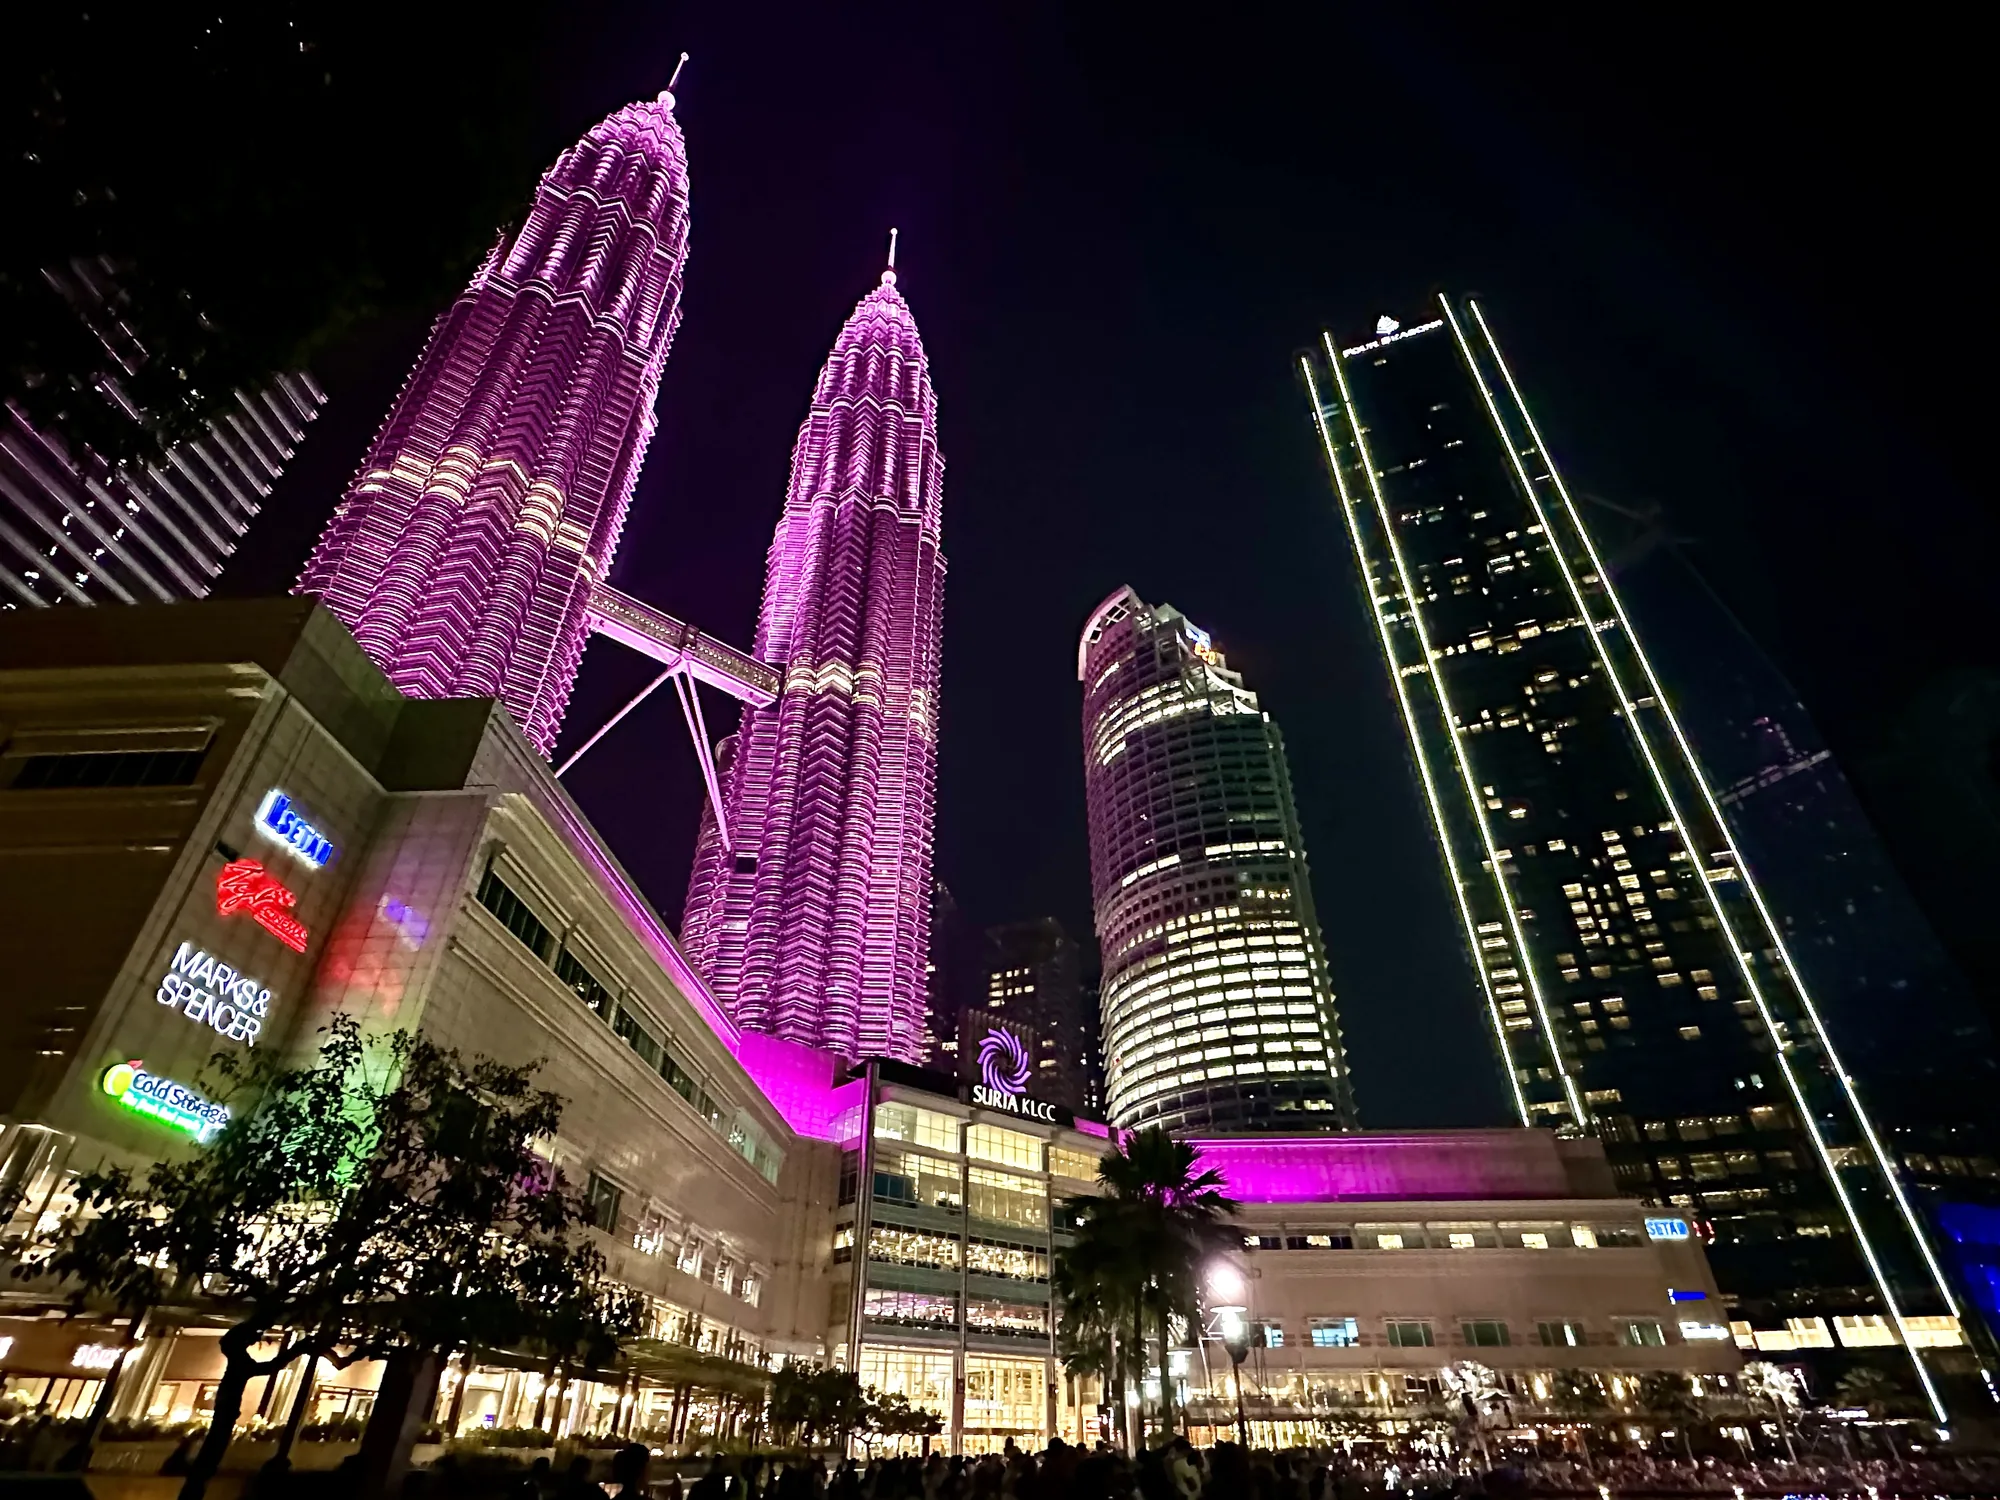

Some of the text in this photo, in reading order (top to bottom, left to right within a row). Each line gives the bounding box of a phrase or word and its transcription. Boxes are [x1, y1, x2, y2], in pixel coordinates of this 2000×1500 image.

[157, 973, 261, 1048] SPENCER
[133, 1073, 170, 1100] Cold
[169, 1088, 228, 1124] Storage
[972, 1085, 1056, 1122] SURIA KLCC
